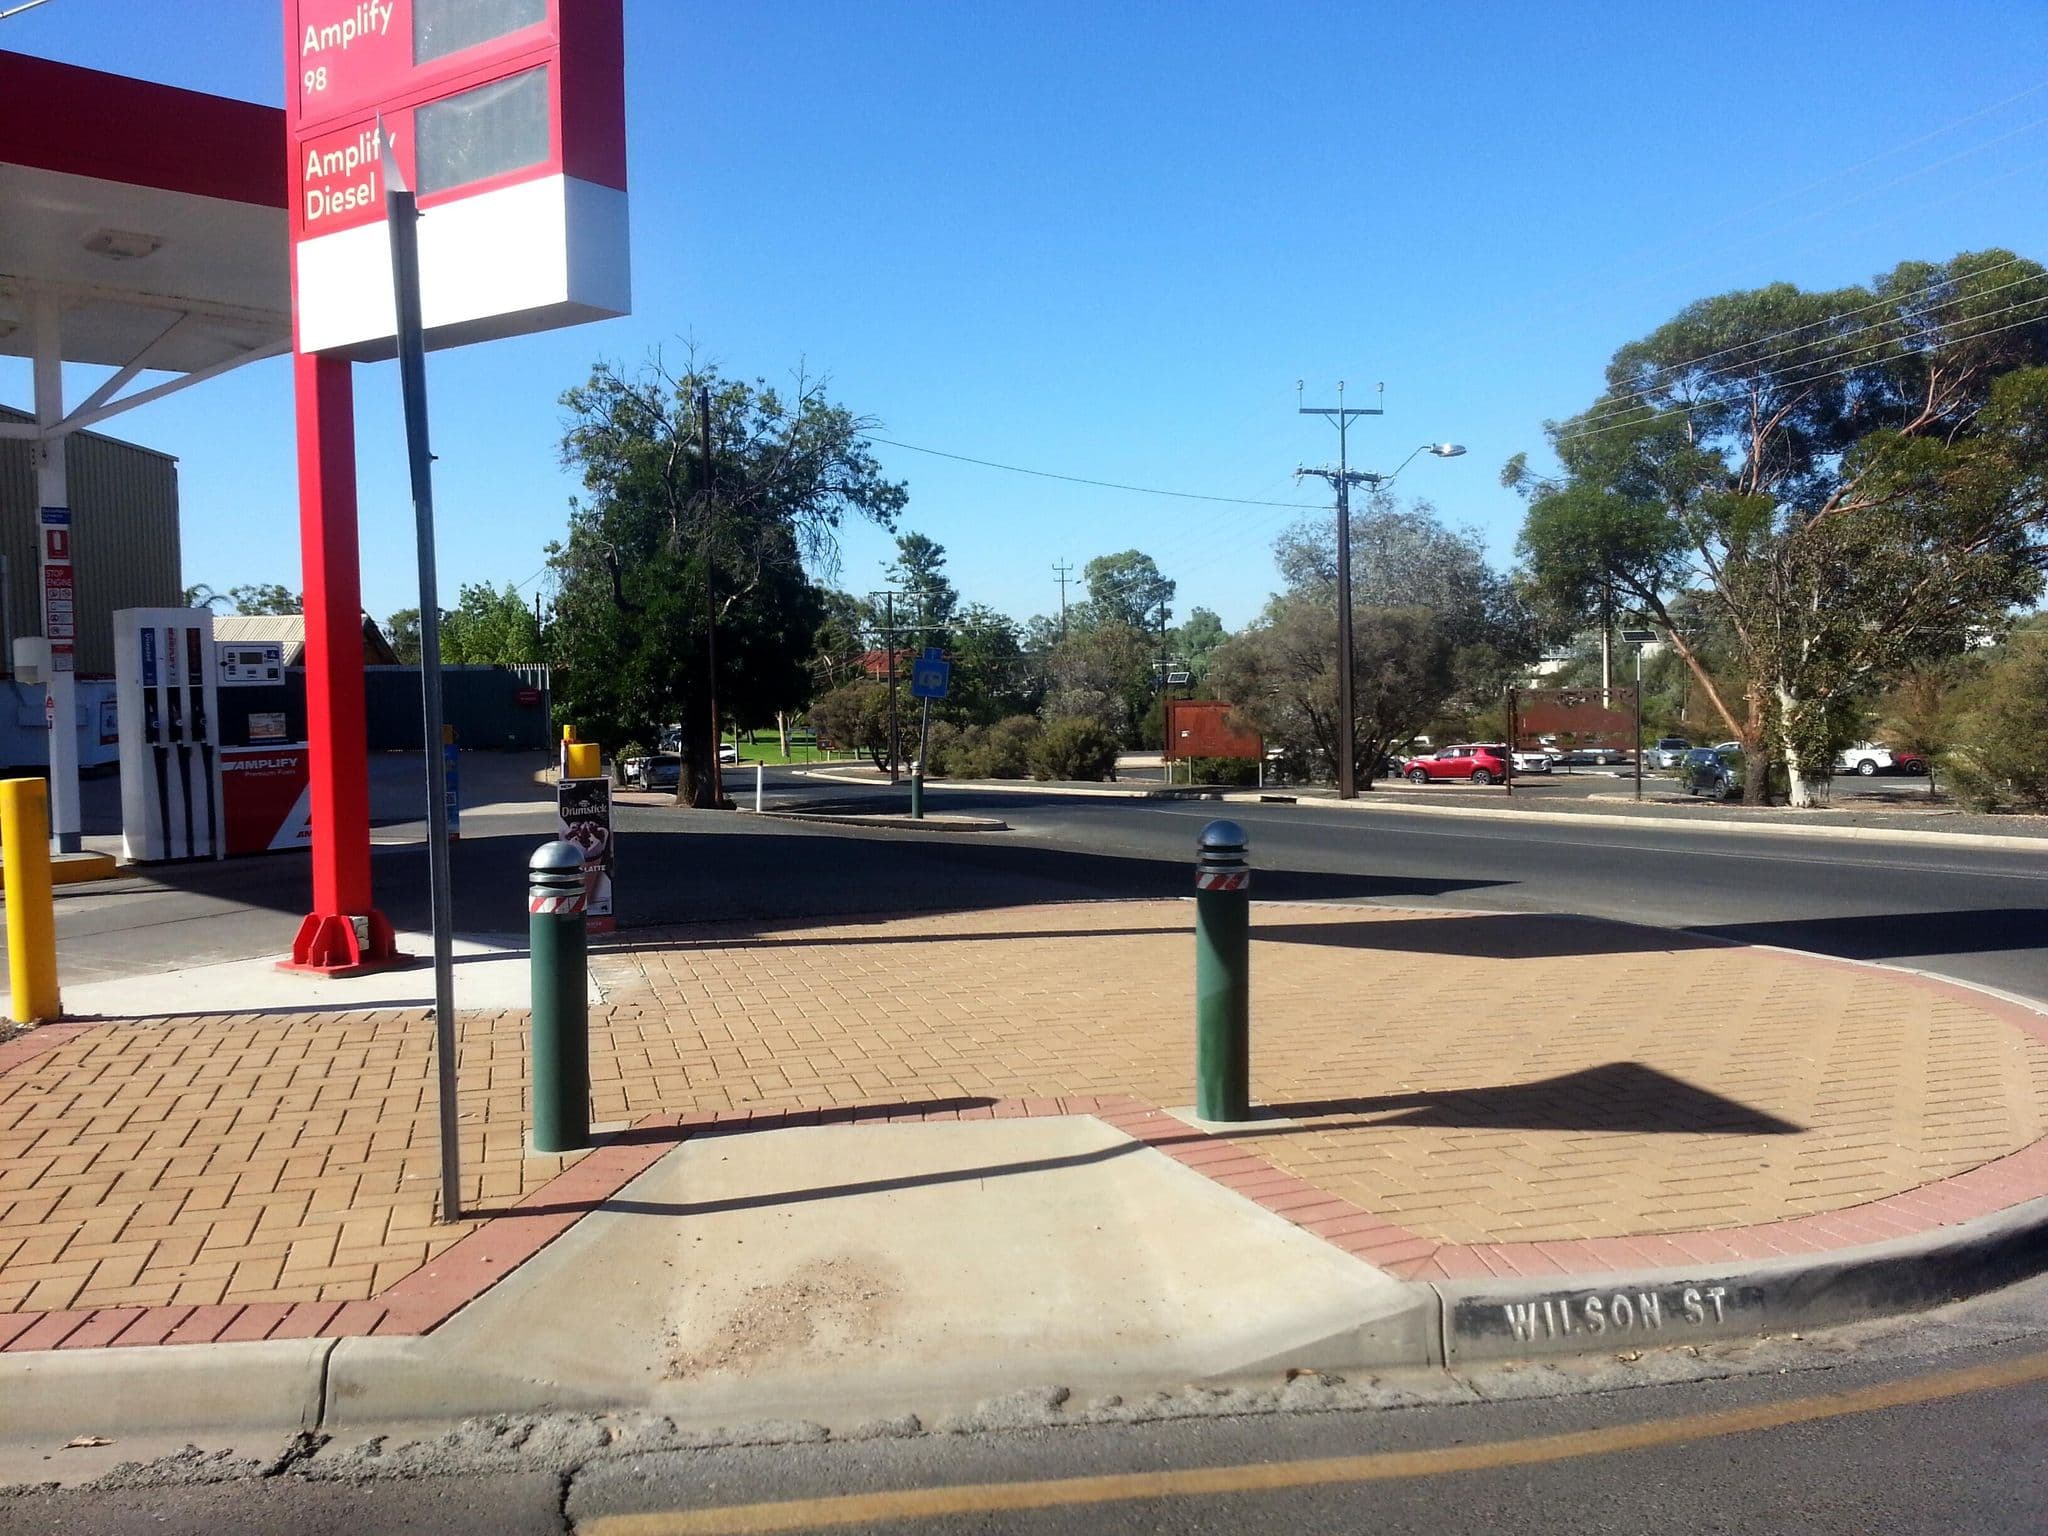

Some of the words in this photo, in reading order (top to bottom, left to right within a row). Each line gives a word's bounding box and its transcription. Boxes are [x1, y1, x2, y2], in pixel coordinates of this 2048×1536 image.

[302, 0, 394, 56] Amplify
[304, 67, 327, 94] 98
[307, 173, 376, 220] Diesel
[235, 757, 298, 770] AMPLIFY
[561, 803, 607, 817] Drumstick
[1503, 1290, 1662, 1342] WILSON
[1682, 1286, 1726, 1328] ST
